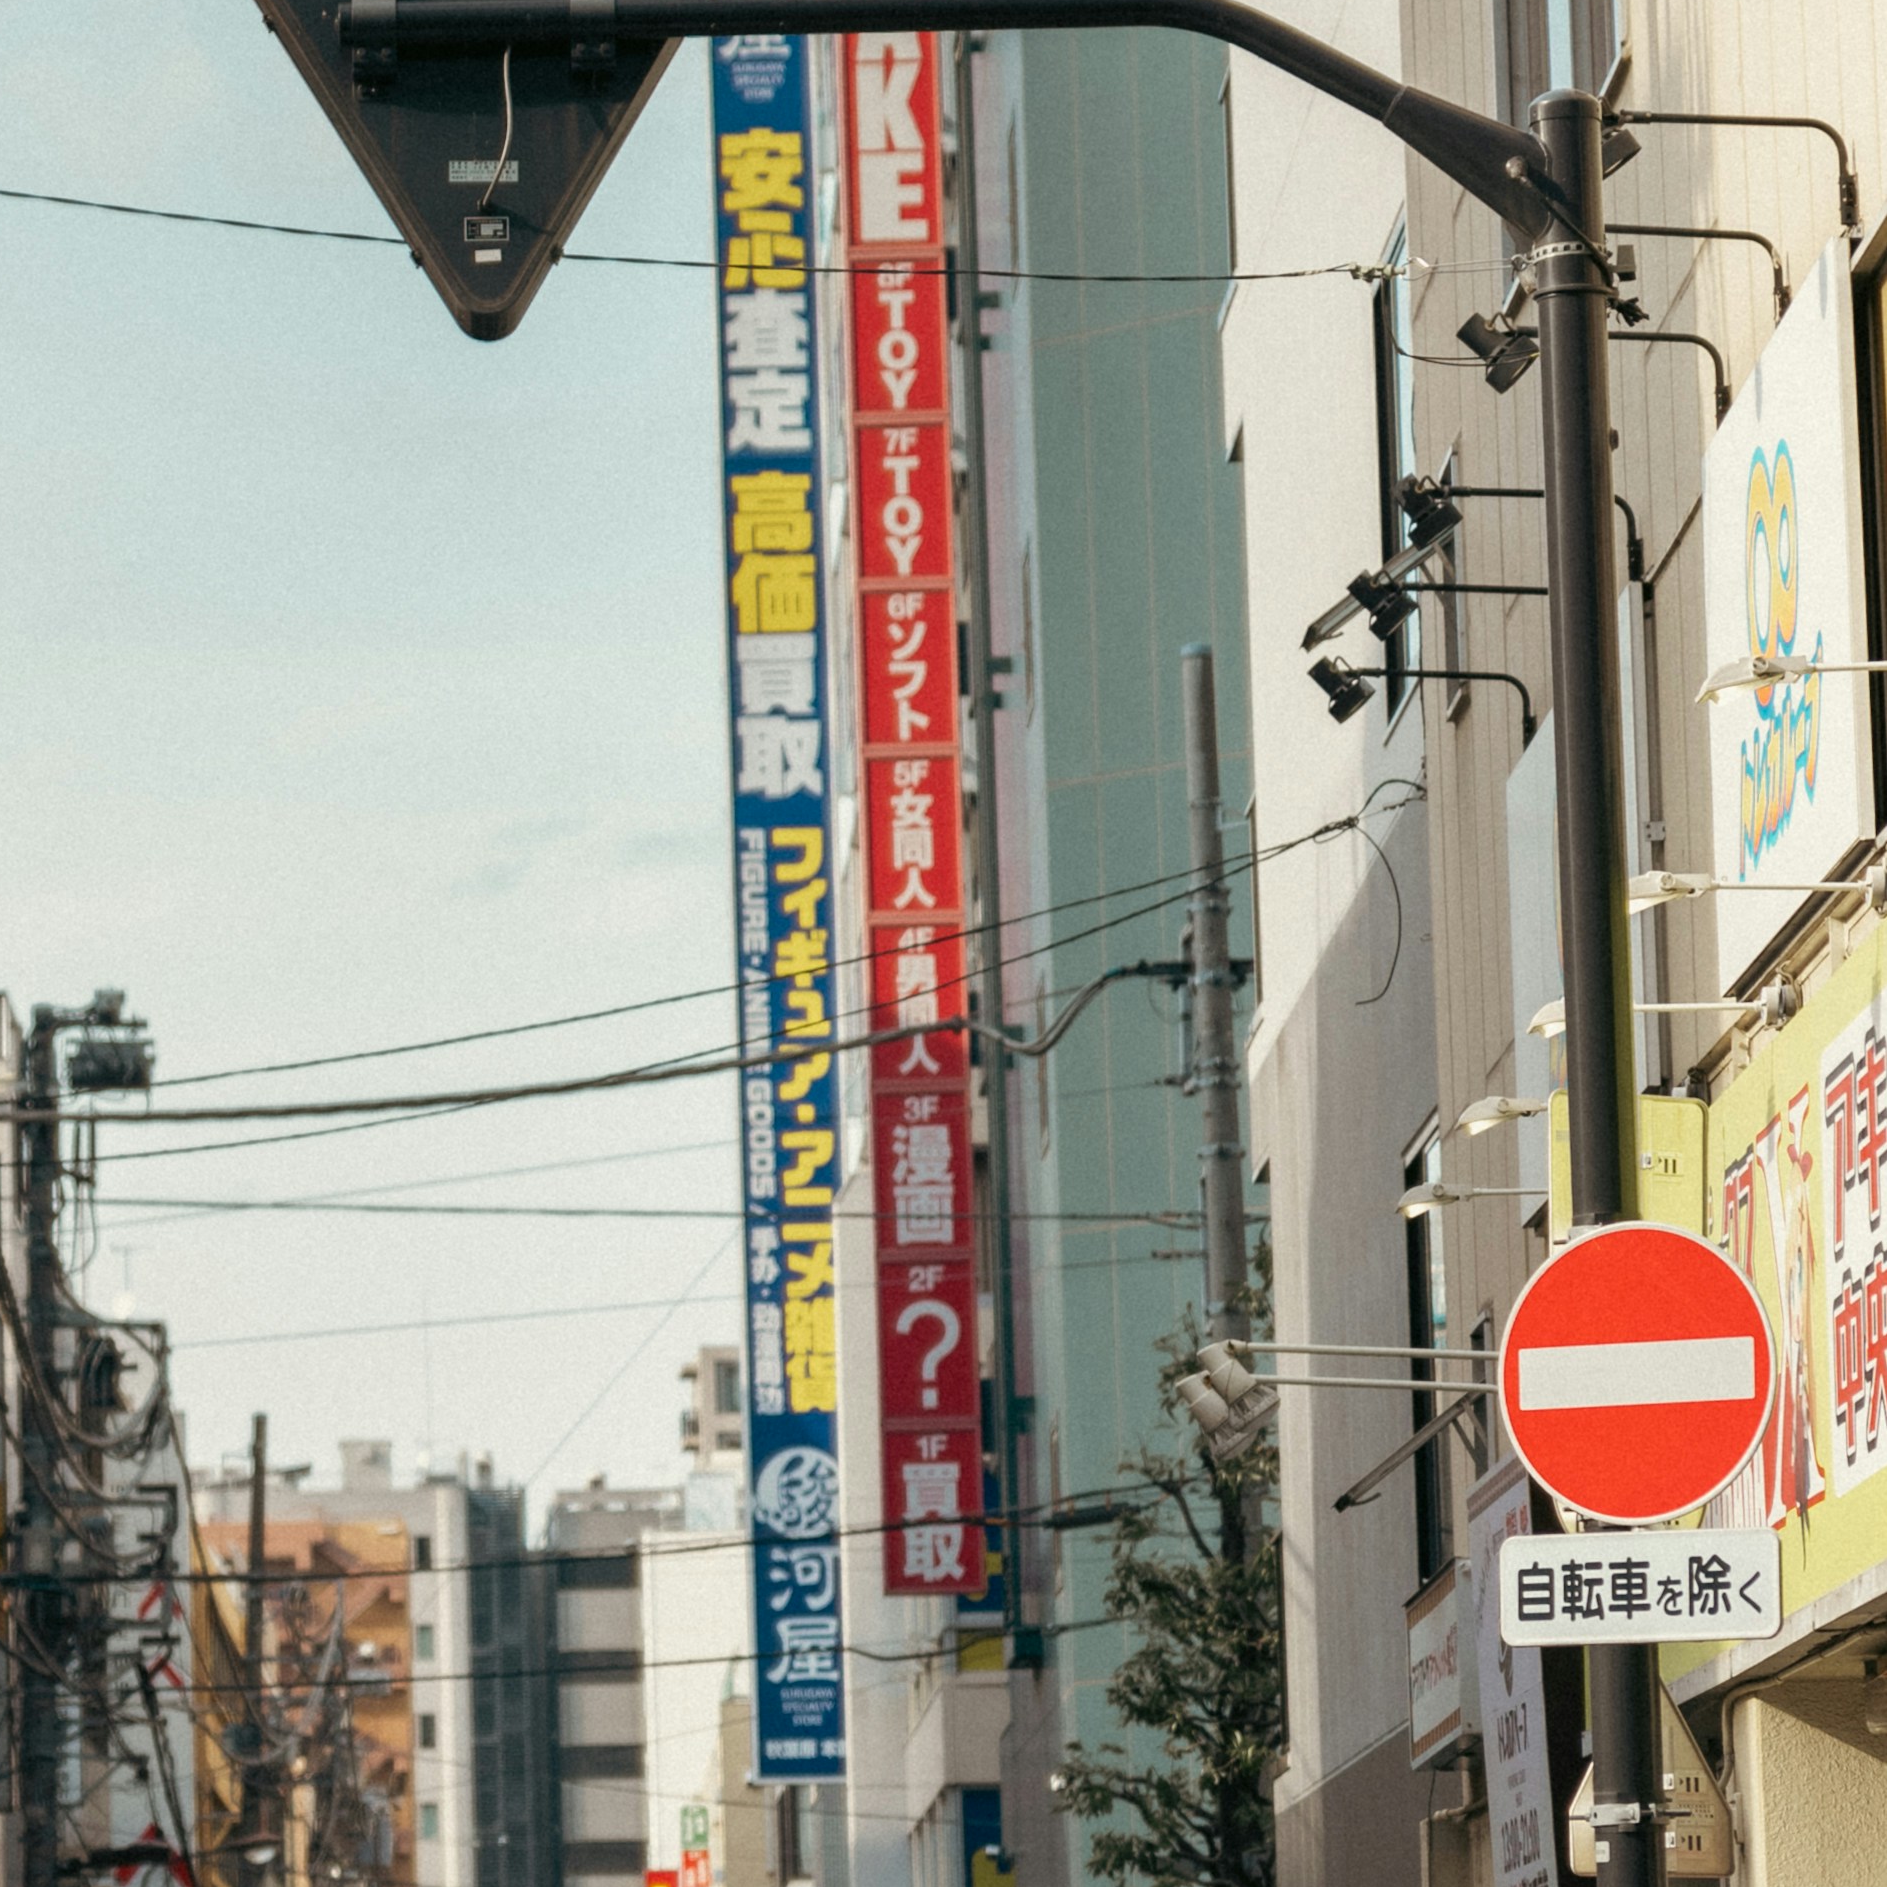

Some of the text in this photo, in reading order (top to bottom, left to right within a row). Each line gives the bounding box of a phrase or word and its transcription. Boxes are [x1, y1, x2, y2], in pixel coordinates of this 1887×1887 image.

[721, 127, 813, 454] 安心査定
[878, 290, 920, 410] TOY
[883, 428, 919, 455] 7F
[883, 455, 923, 576] TOY
[731, 470, 823, 799] 高価買取
[887, 621, 930, 742] ソフト
[890, 788, 937, 910] 女同人
[892, 1124, 954, 1246] 漫画
[909, 1266, 944, 1293] 2F
[915, 1434, 947, 1460] 1F
[756, 1445, 840, 1684] 駿河屋
[902, 1462, 965, 1583] 買取
[1518, 1554, 1762, 1622] 自転車を除く
